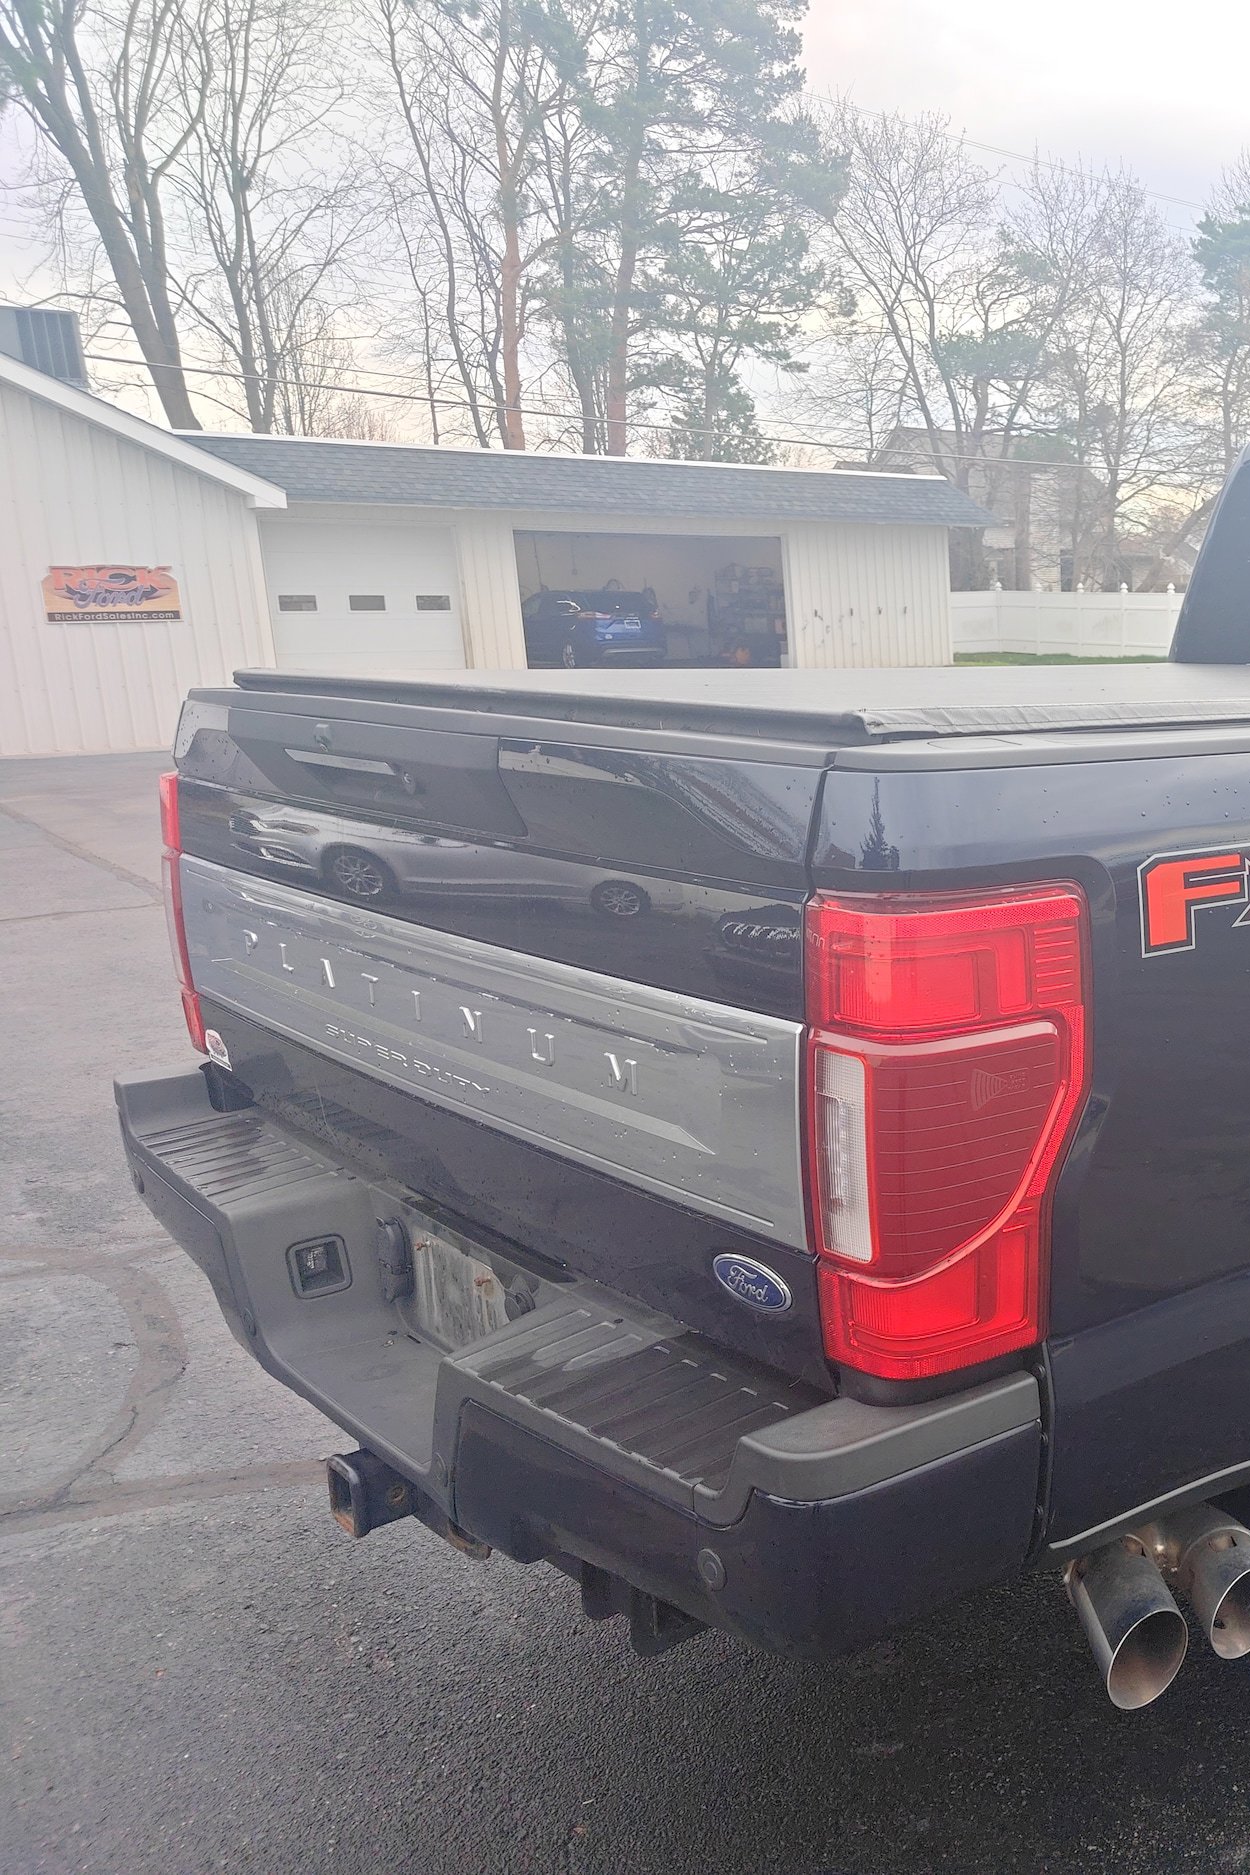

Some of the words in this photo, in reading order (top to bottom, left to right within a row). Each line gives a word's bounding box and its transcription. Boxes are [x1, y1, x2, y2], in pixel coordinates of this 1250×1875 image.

[49, 565, 172, 591] RICK
[73, 577, 147, 609] Ford
[54, 612, 175, 622] RickFordSalesInc.com
[242, 928, 638, 1097] PLATINUM
[727, 1264, 769, 1303] Ford
